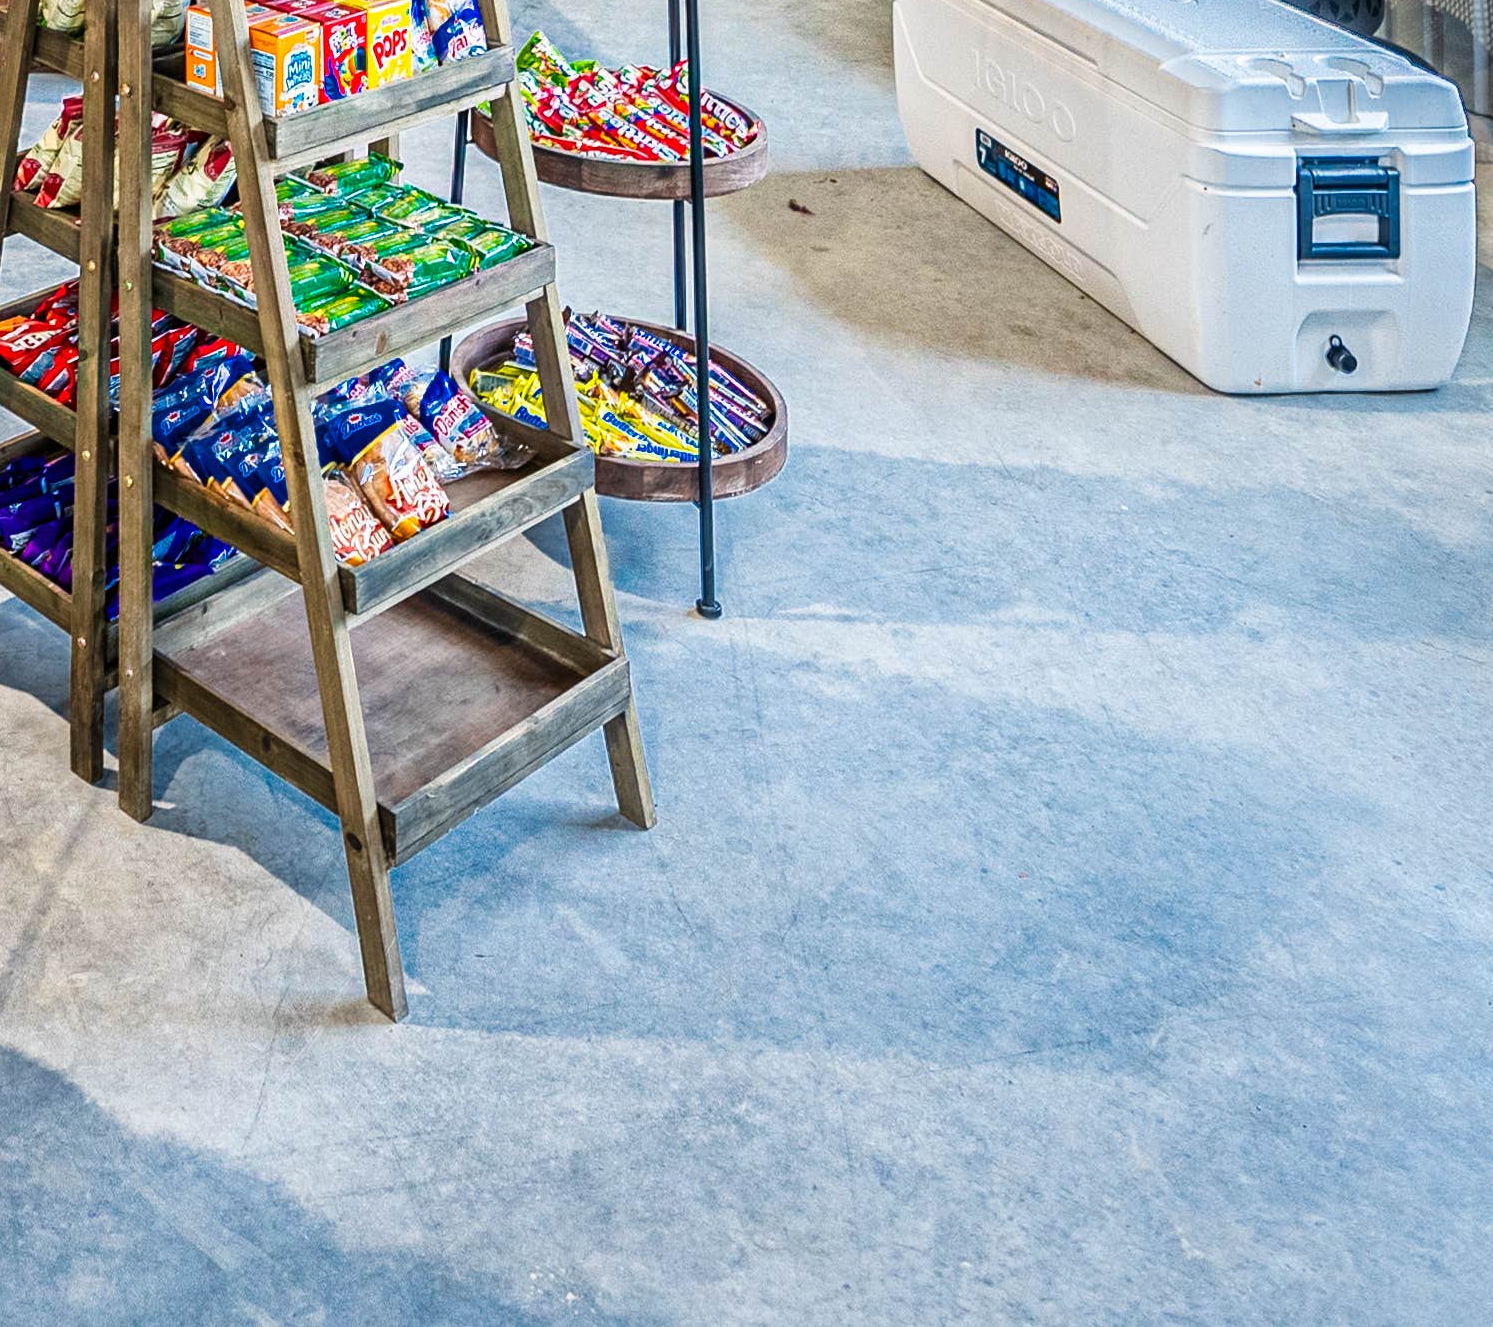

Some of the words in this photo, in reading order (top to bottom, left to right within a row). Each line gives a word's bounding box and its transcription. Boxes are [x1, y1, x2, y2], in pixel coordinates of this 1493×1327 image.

[287, 58, 312, 76] Mini
[371, 29, 408, 69] POPS
[286, 69, 313, 91] Wheats
[973, 48, 1077, 143] IGLOO
[434, 390, 473, 437] Danish
[636, 441, 702, 463] utterfinger
[395, 460, 436, 508] Honey
[414, 488, 447, 523] Bun
[329, 508, 370, 548] Honey
[353, 528, 391, 560] Bun
